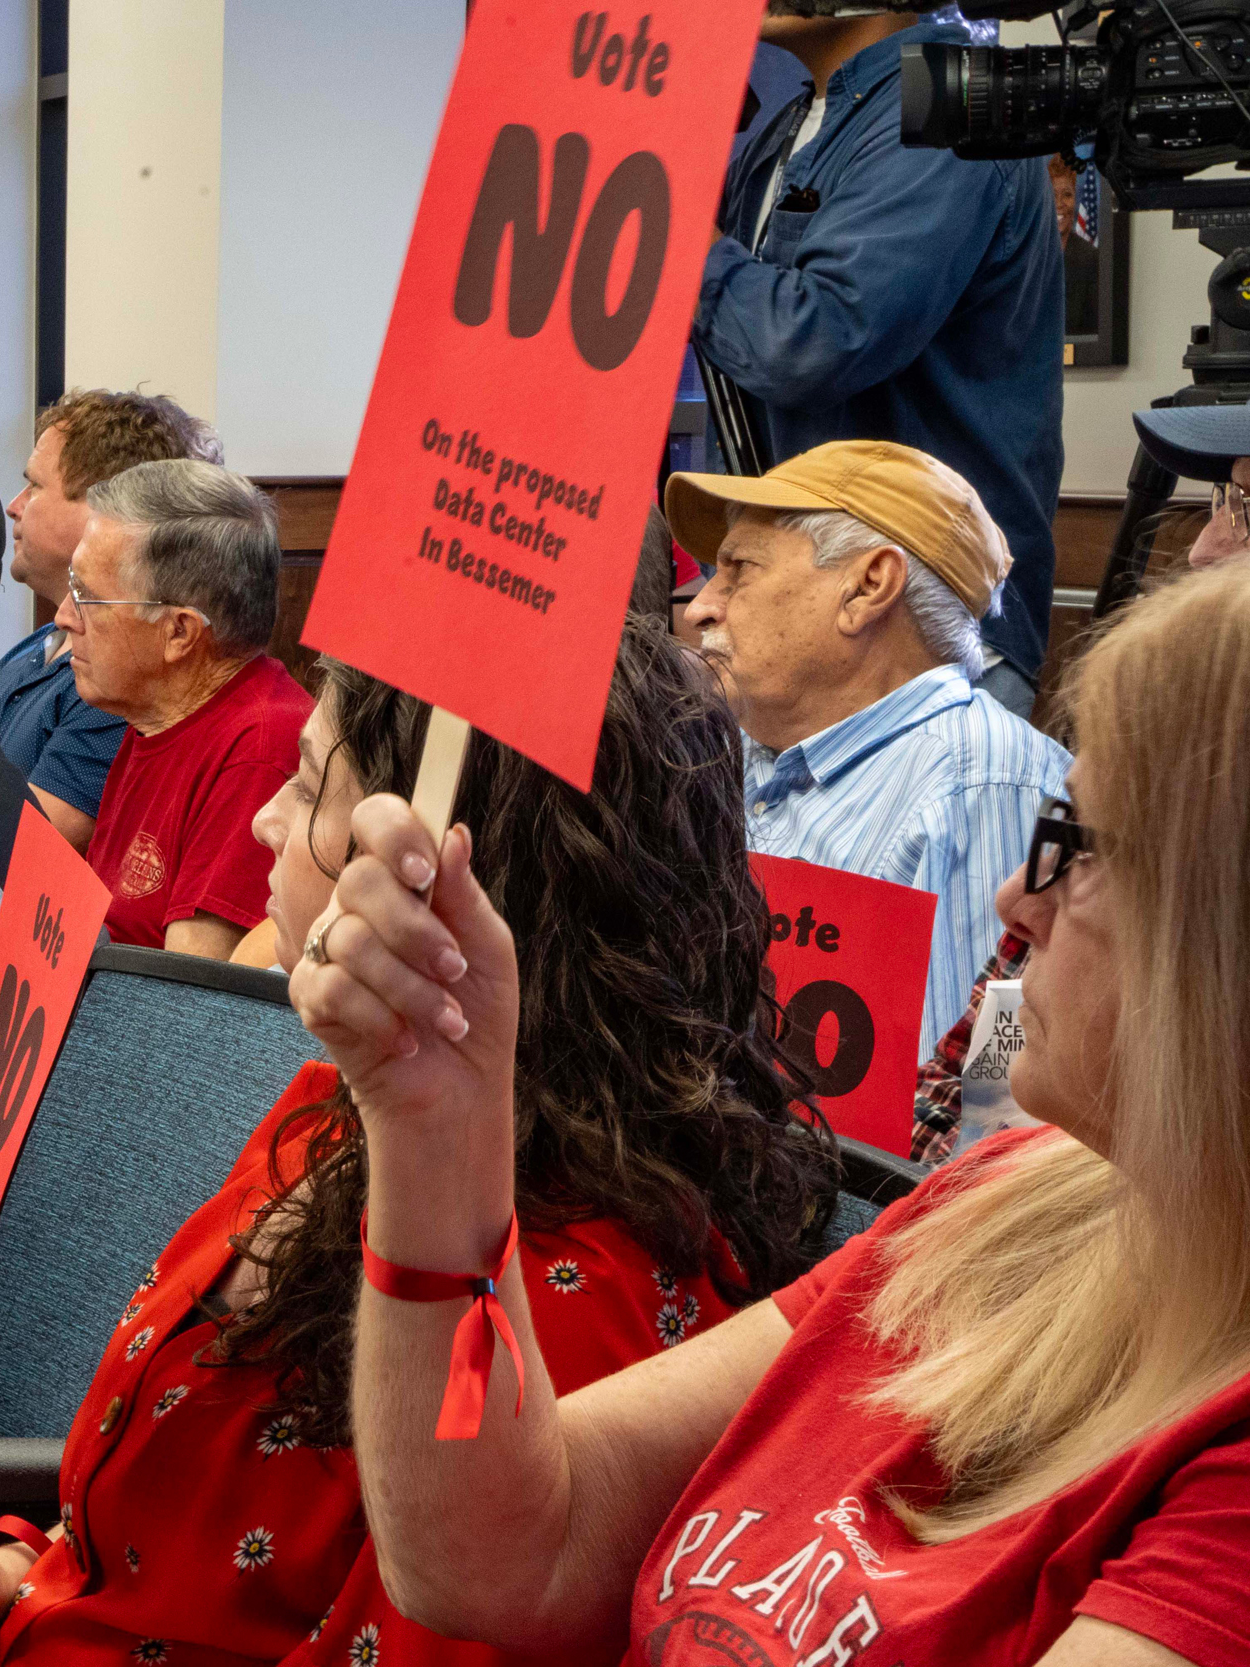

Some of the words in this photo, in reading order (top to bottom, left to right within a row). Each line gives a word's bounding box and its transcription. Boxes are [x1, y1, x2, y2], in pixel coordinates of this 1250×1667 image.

[572, 11, 669, 98] Vote
[453, 123, 672, 372] NO
[422, 417, 452, 458] On
[454, 429, 496, 476] the
[494, 456, 605, 521] proposed
[433, 477, 486, 528] Data
[488, 501, 567, 562] Center
[417, 526, 444, 564] In
[446, 537, 556, 615] Bessemer
[32, 892, 65, 970] Vote
[770, 906, 841, 953] ote
[762, 968, 876, 1098] O
[993, 1025, 1023, 1038] ACE
[997, 1039, 1026, 1052] MIN
